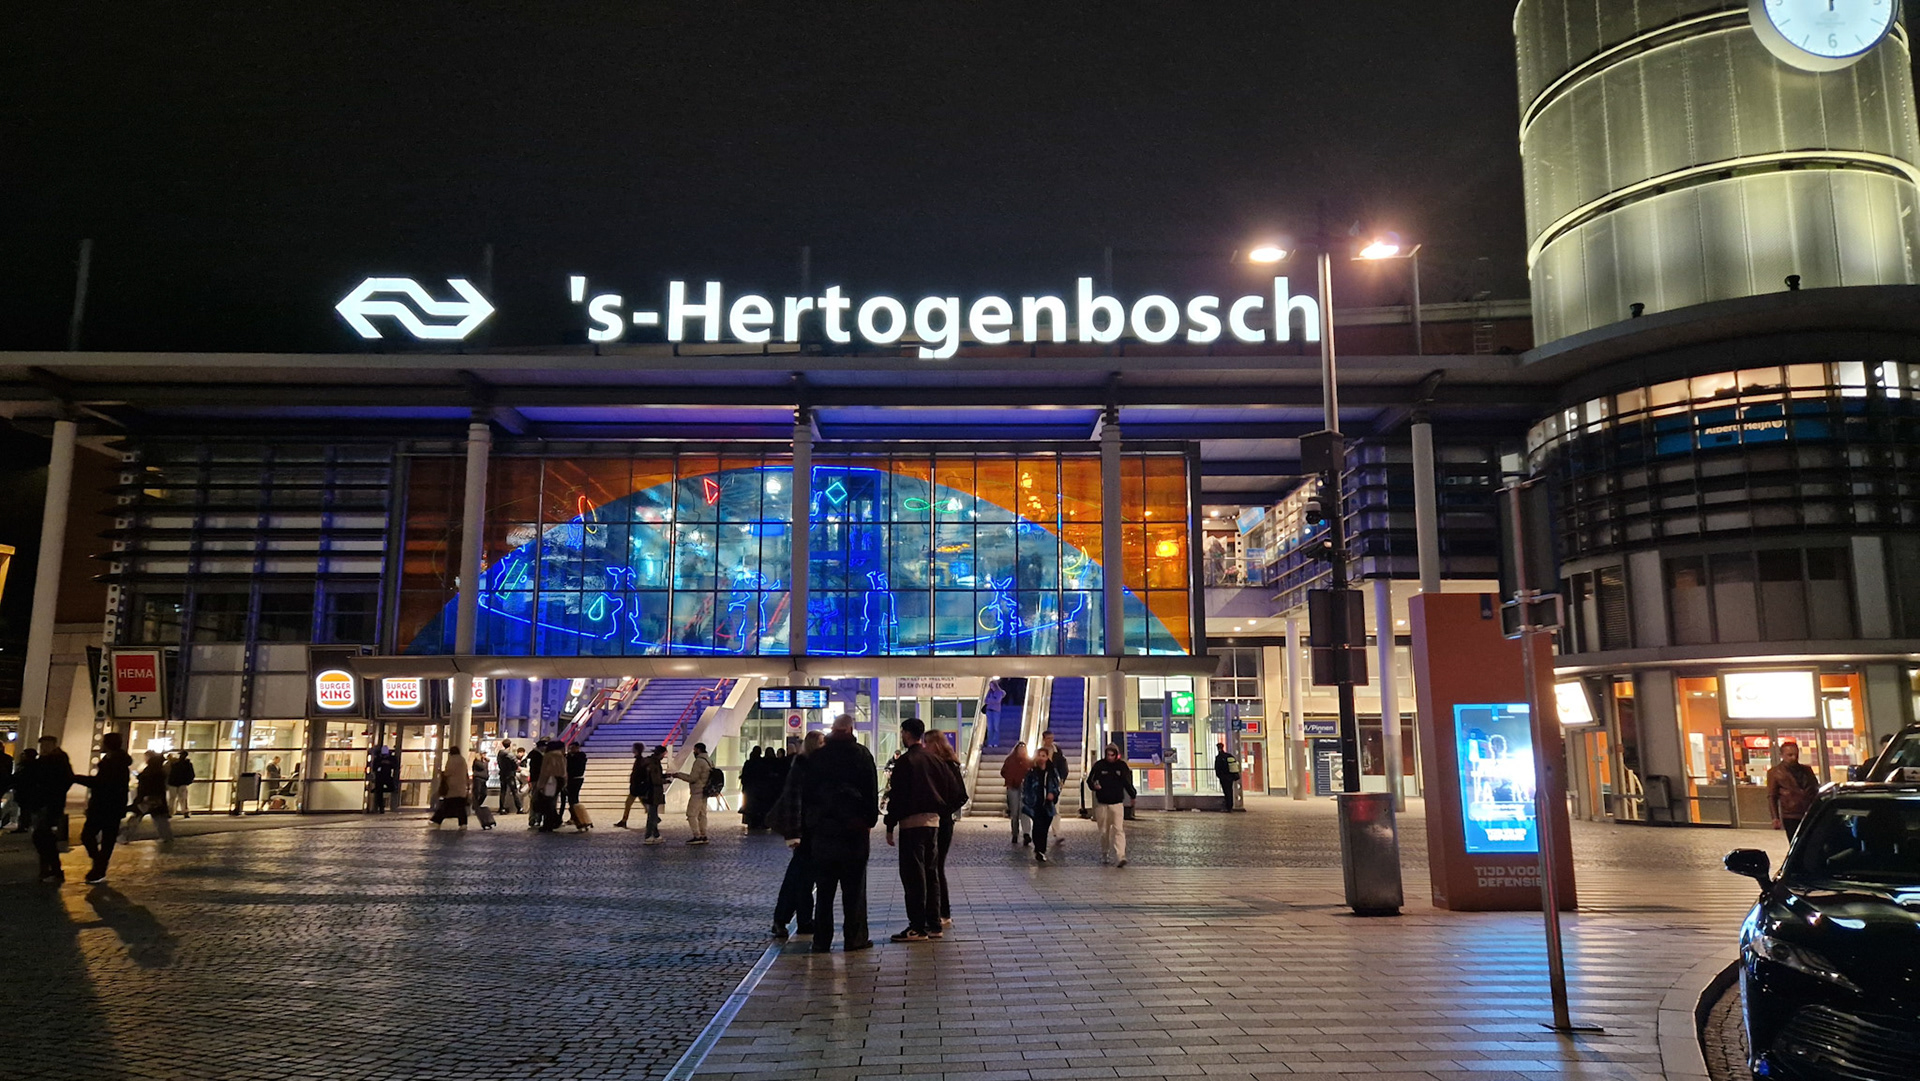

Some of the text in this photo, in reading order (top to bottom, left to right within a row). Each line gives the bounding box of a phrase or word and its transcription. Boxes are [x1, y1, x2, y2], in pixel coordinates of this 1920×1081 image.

[1828, 33, 1838, 49] 6
[569, 275, 1320, 358] 's-Hertogenbosch
[118, 668, 154, 679] HEMA
[320, 690, 351, 699] KING
[386, 690, 418, 699] KING
[1474, 866, 1505, 876] TIJD
[1478, 877, 1543, 887] DEFENSIE
